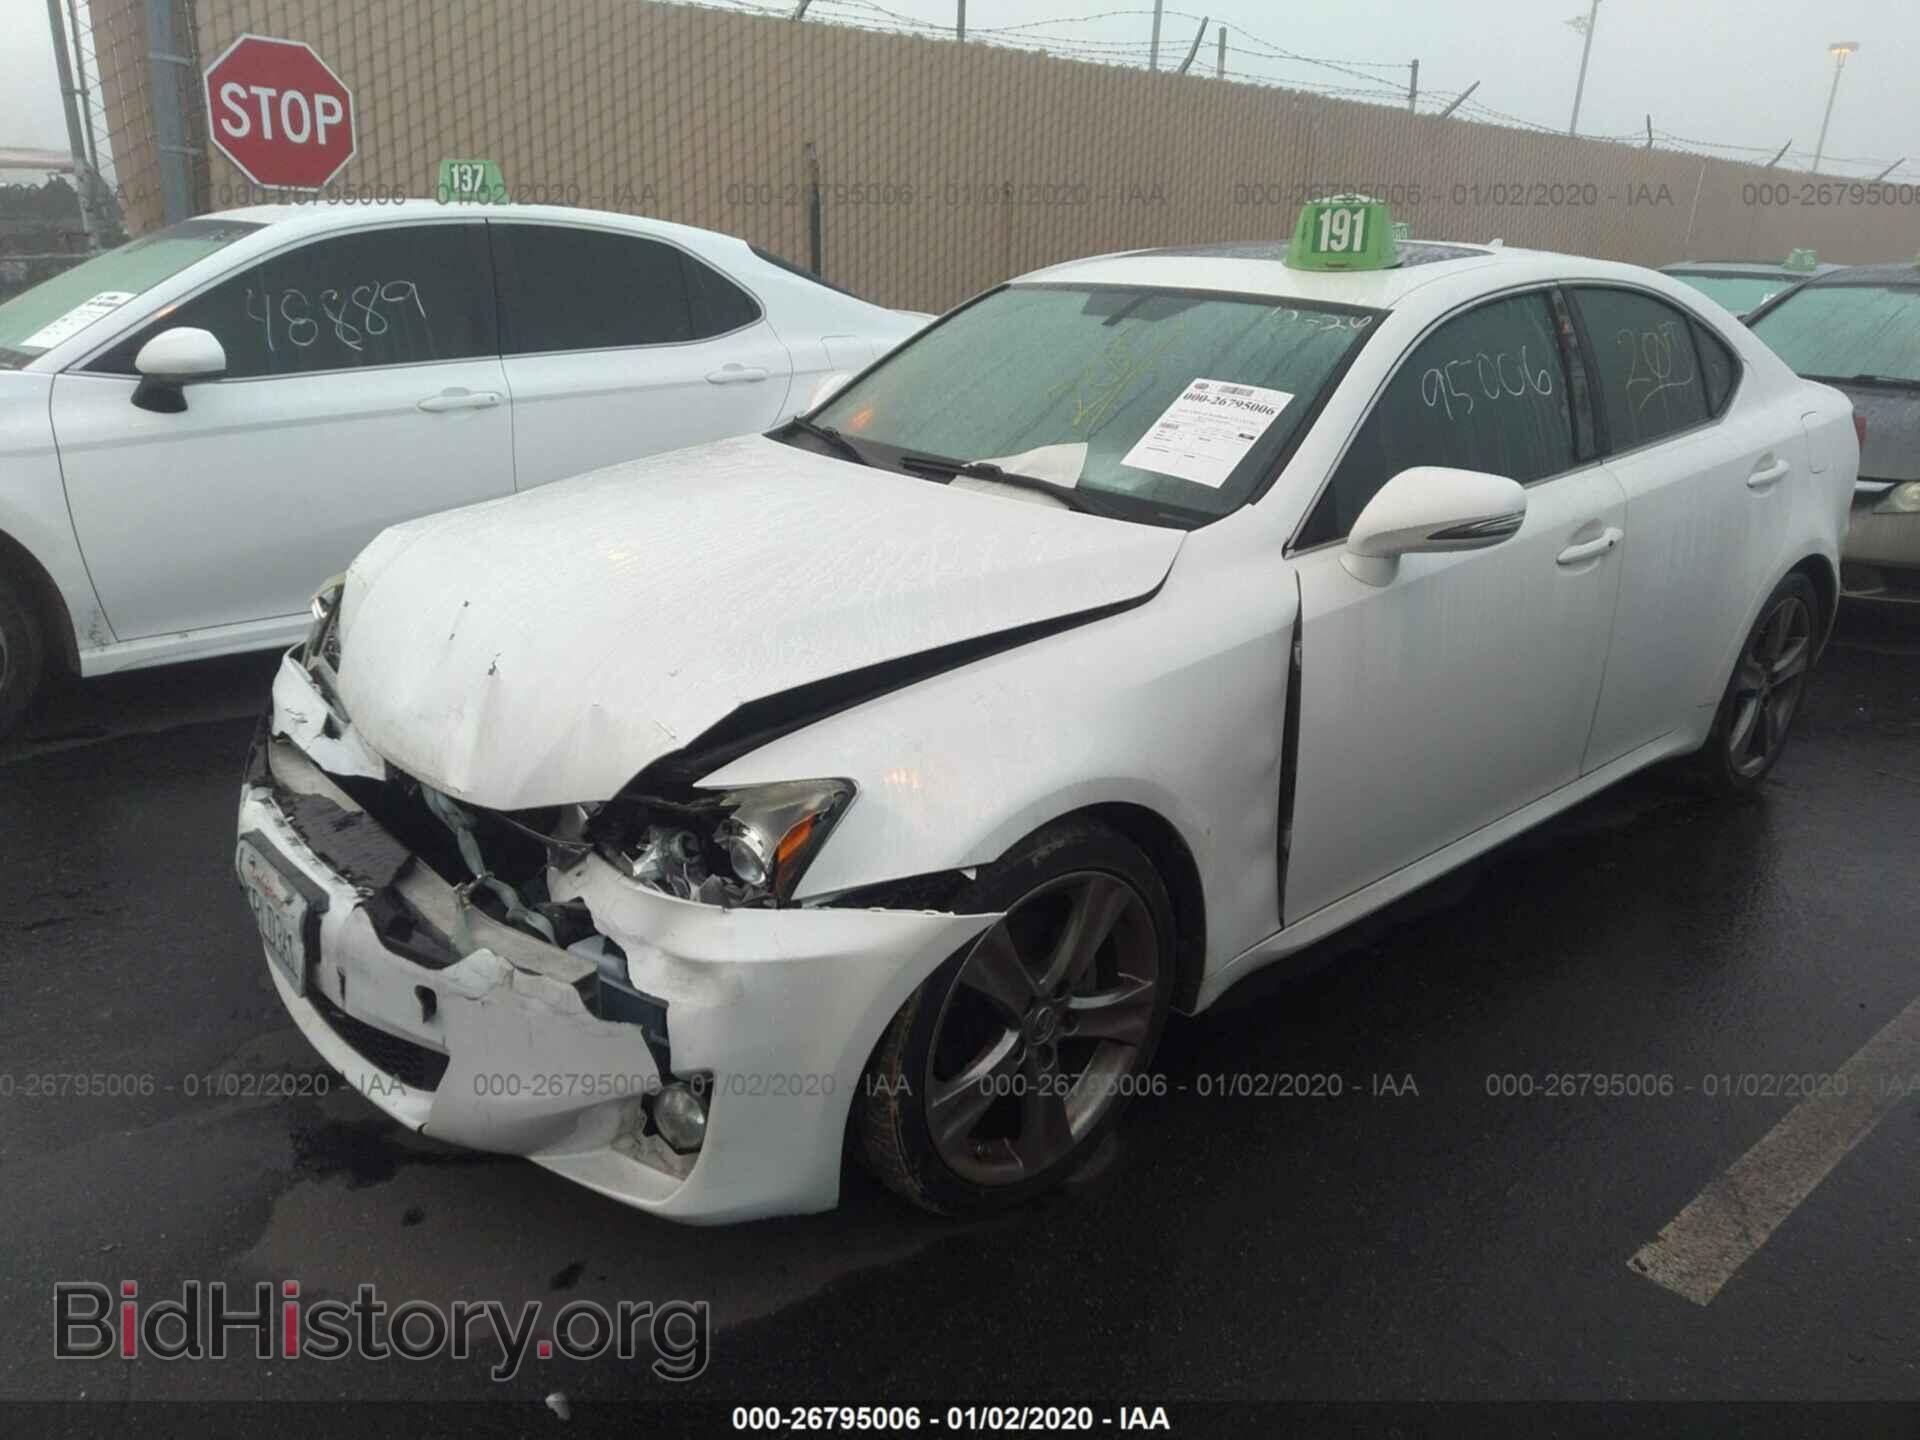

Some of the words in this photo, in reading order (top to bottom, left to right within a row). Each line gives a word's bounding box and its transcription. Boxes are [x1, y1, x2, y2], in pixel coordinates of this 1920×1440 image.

[220, 82, 344, 145] STOP
[449, 164, 485, 192] 137
[1318, 207, 1366, 254] 191
[1182, 391, 1276, 417] 000-26795006
[1421, 344, 1553, 421] 95006
